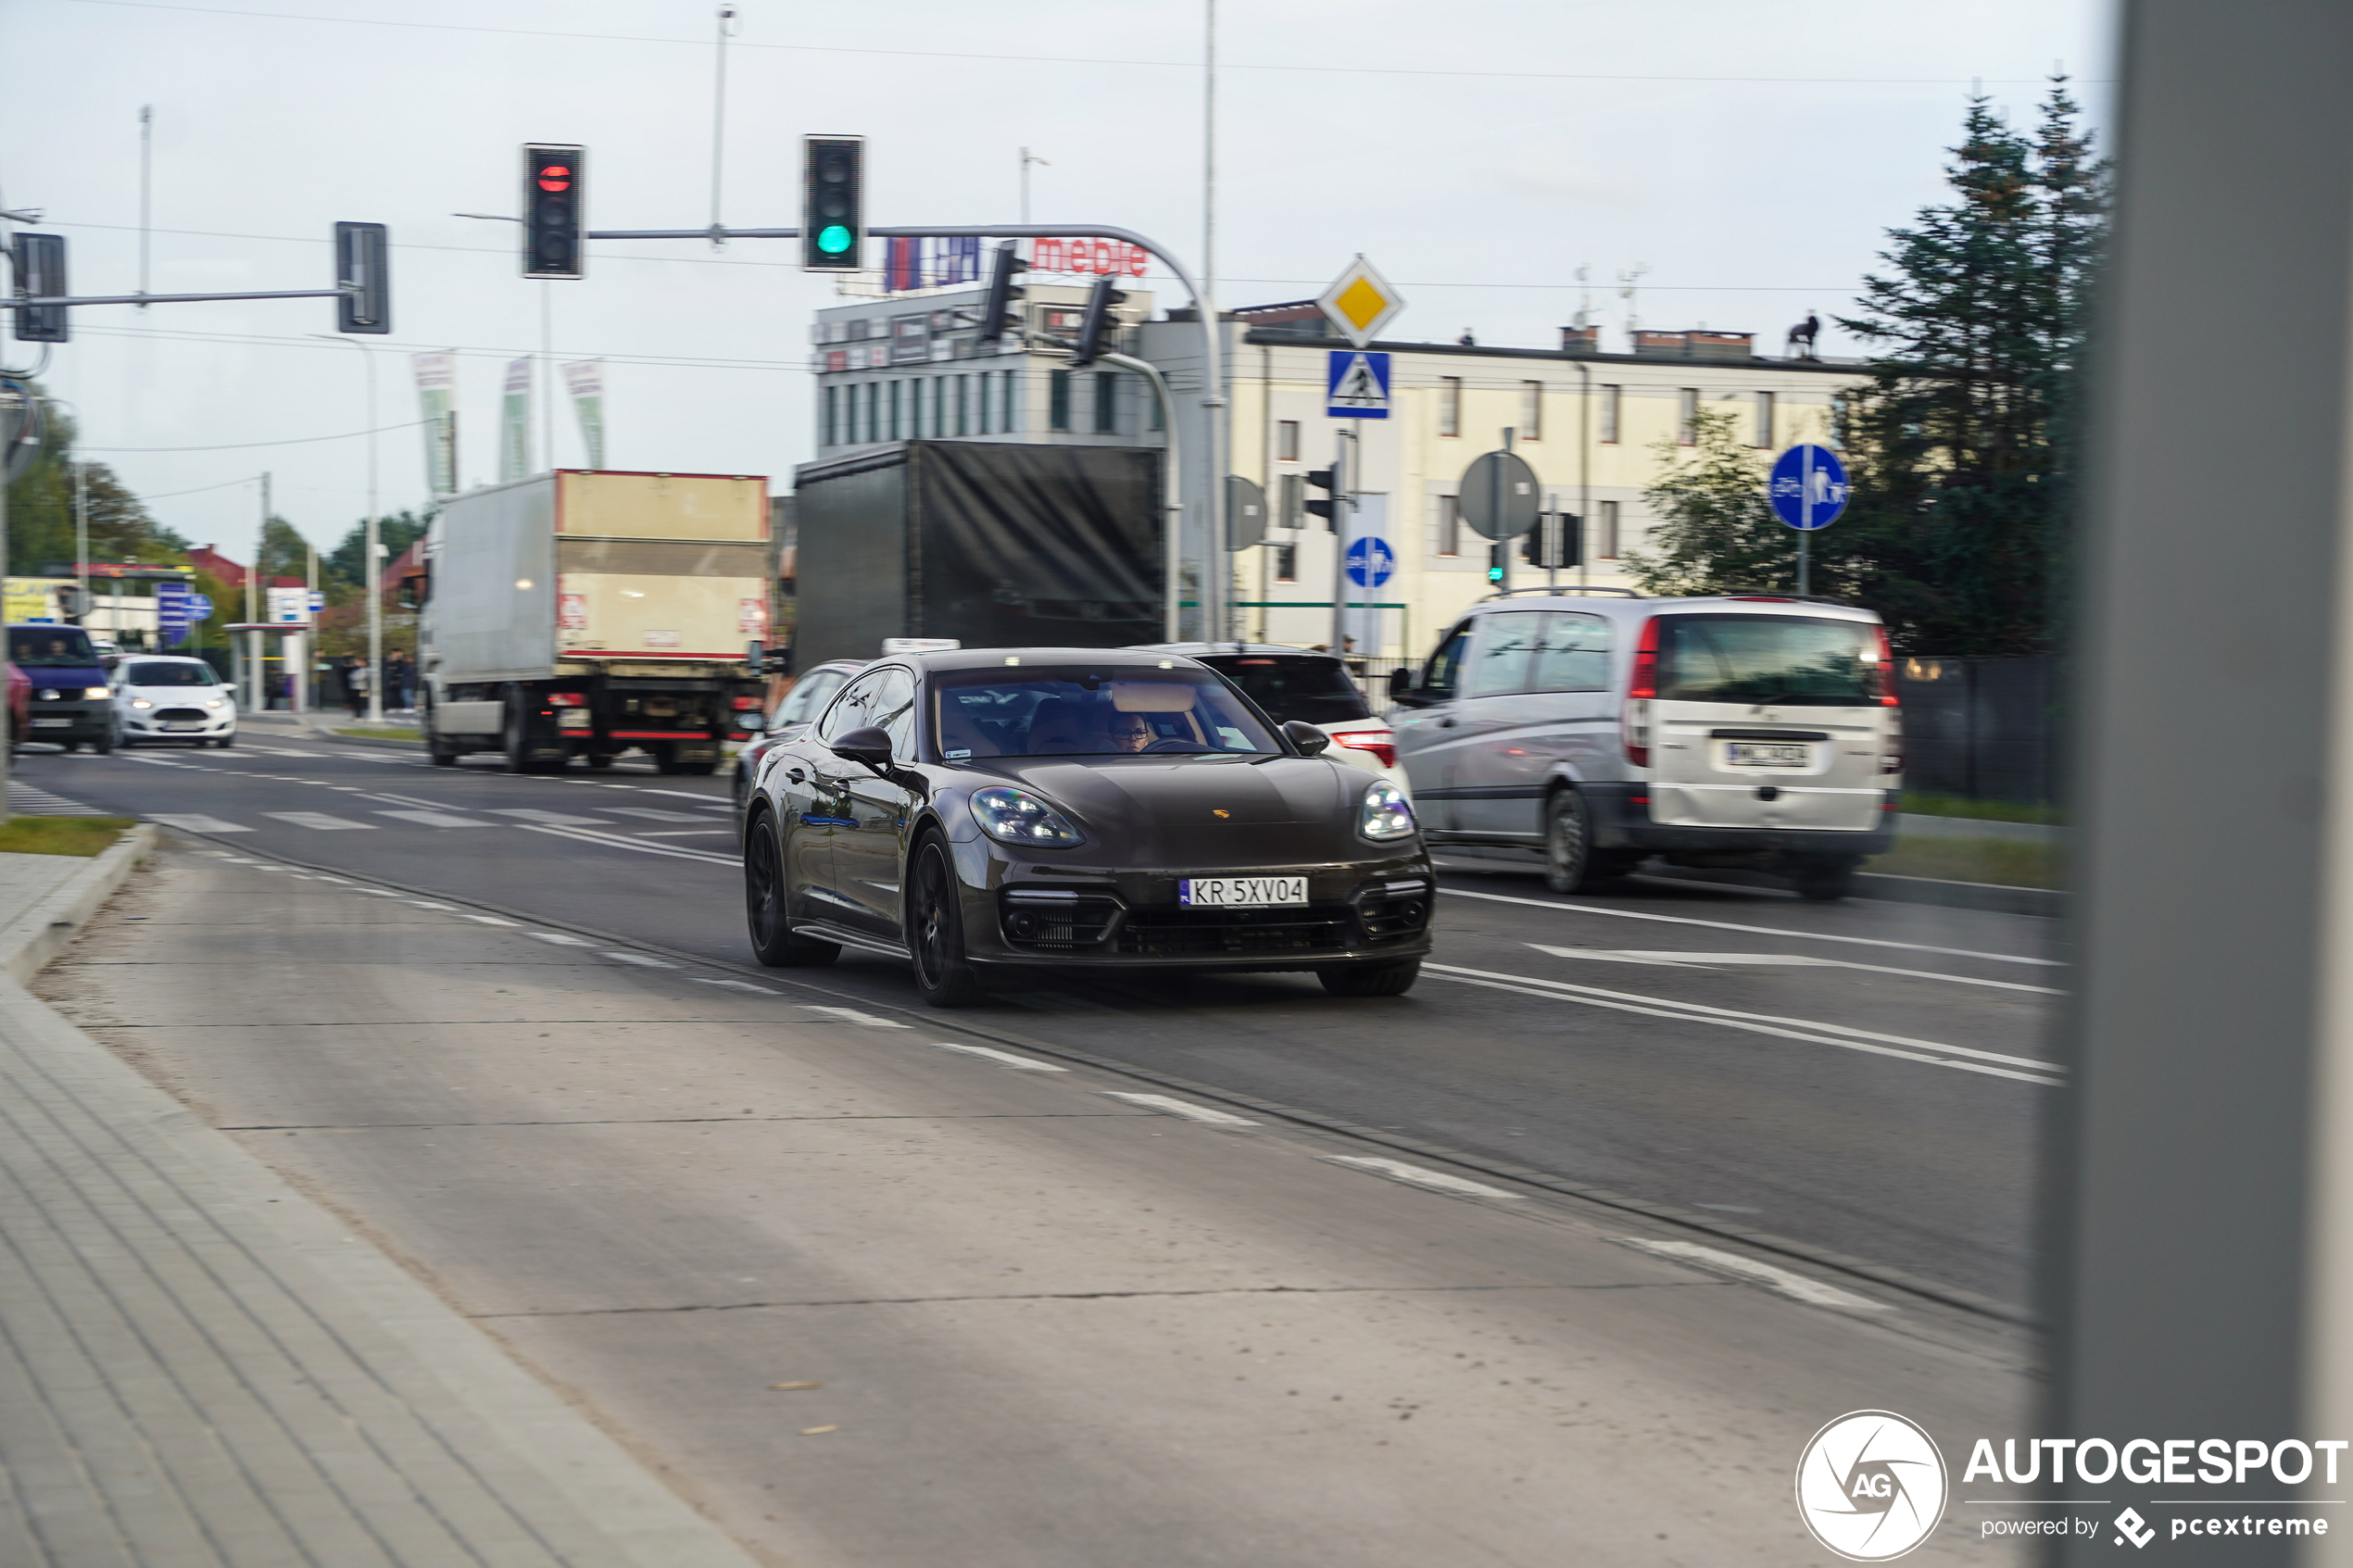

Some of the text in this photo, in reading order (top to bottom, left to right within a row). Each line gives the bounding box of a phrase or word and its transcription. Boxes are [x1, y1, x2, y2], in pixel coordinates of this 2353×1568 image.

[1034, 237, 1149, 276] meble
[1195, 879, 1302, 903] KR 5XV04
